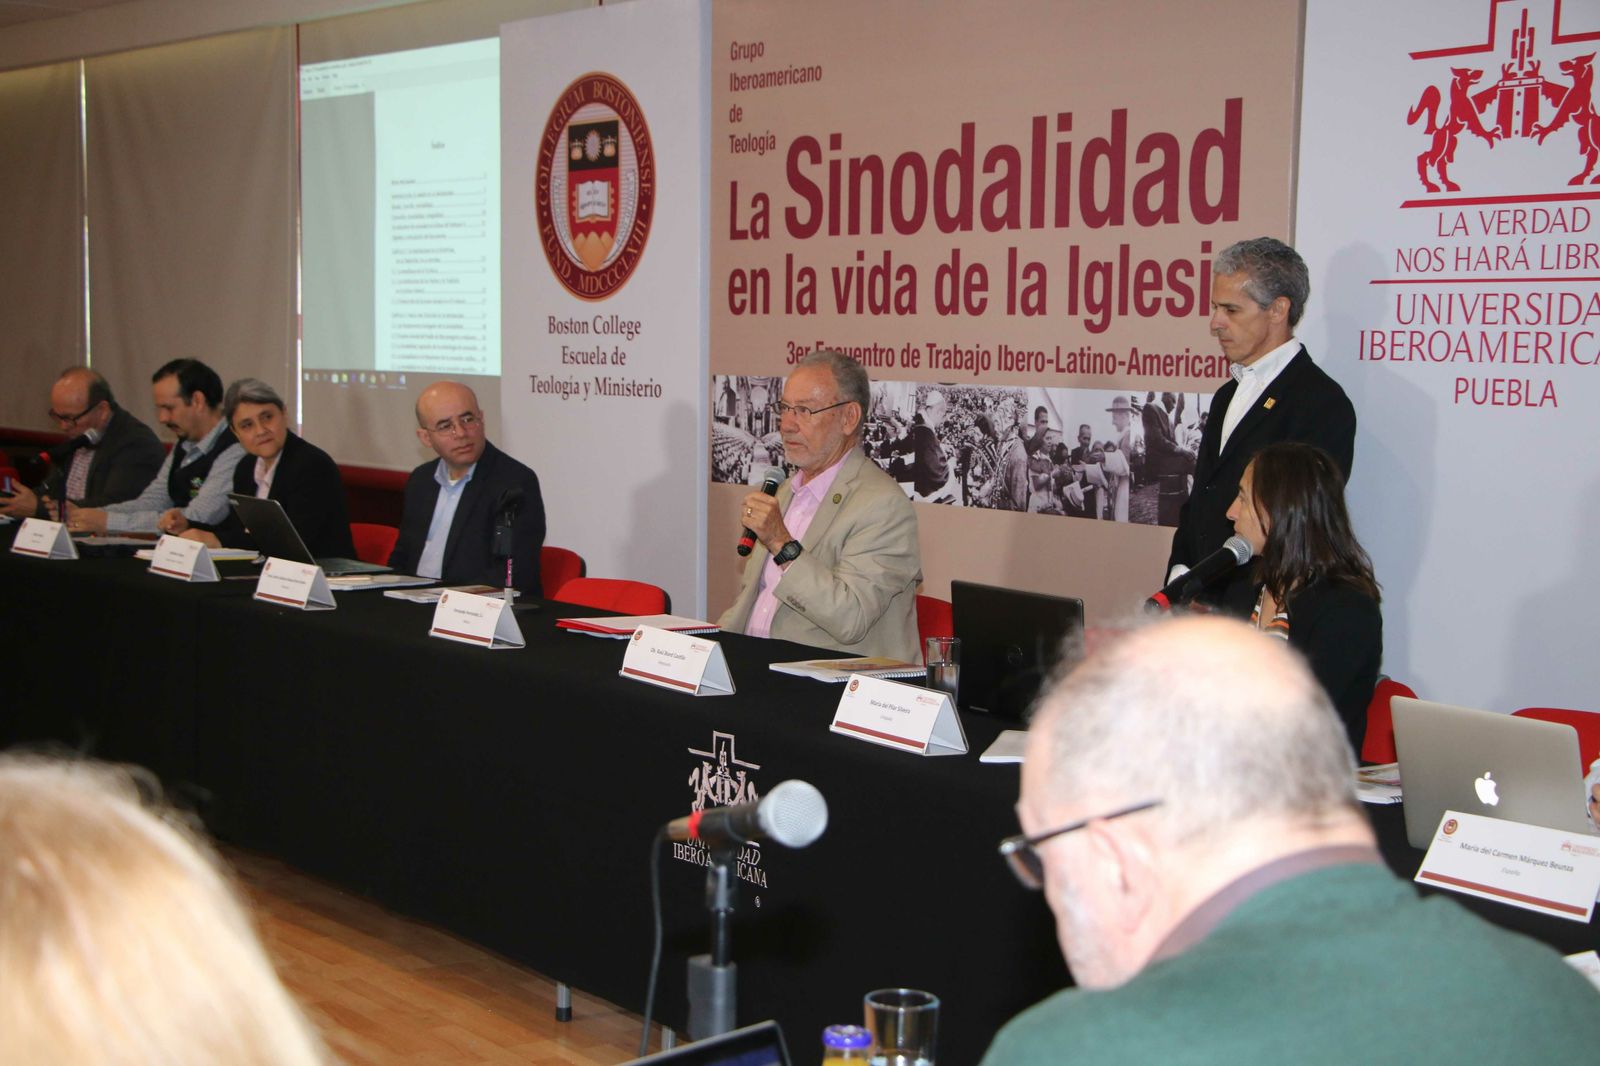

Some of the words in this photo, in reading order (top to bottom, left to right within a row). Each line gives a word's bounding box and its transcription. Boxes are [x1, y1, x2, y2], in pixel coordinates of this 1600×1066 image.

[730, 41, 765, 62] Grupo
[730, 64, 822, 92] Iberoamericano
[729, 104, 743, 123] de
[729, 130, 776, 156] Teología
[729, 181, 770, 240] La
[784, 97, 1243, 239] Sinodalidad
[1438, 211, 1469, 237] LA
[1479, 206, 1591, 235] VERDAD
[1396, 247, 1445, 273] NOS
[1454, 238, 1530, 272] HARÁ
[1540, 243, 1600, 271] LIBR
[728, 266, 770, 316] en
[784, 252, 817, 315] la
[831, 250, 918, 316] vida
[934, 248, 988, 317] de
[1007, 246, 1047, 316] la
[1068, 241, 1212, 334] Iglesi
[1396, 292, 1600, 326] UNIVERSIDA
[548, 315, 589, 334] Boston
[593, 315, 642, 341] College
[562, 345, 607, 365] Escuela
[611, 346, 626, 365] de
[901, 342, 921, 368] de
[926, 343, 992, 376] Trabajo
[997, 344, 1231, 378] Ibero-Latino-American
[1358, 330, 1600, 365] IBEROAMERIC
[530, 374, 579, 400] Teología
[583, 381, 591, 401] y
[594, 376, 662, 398] Ministerio
[1455, 377, 1558, 408] PUEBLA
[673, 842, 768, 888] IBEROAICANA
[1480, 846, 1492, 855] del
[1492, 848, 1518, 861] Carmen
